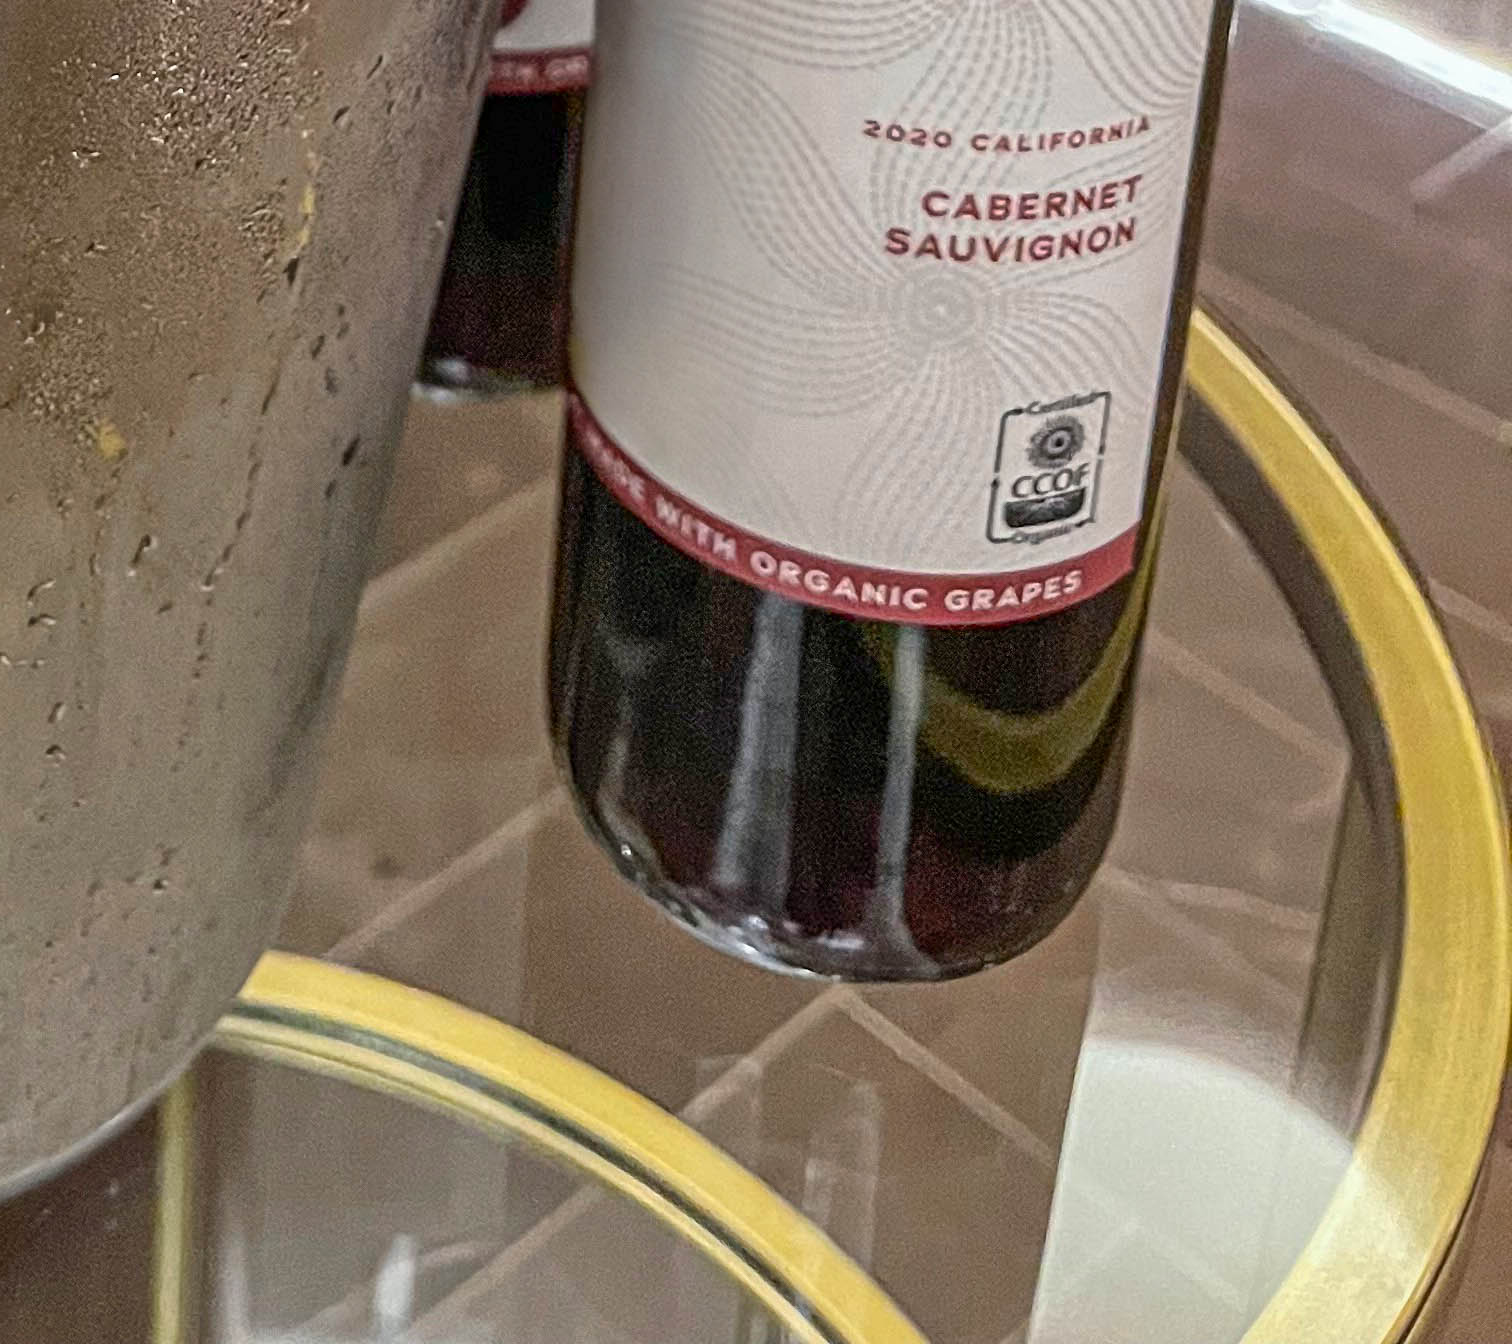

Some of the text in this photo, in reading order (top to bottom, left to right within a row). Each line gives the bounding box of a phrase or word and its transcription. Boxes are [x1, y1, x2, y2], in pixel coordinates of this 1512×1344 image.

[863, 115, 1151, 153] 2020 CALIFORNIA
[921, 174, 1144, 222] CABERNET
[885, 216, 1138, 263] SAUVIGNON
[654, 493, 737, 560] WITH
[749, 549, 929, 611] ORGANIC
[943, 569, 1084, 613] GRAPES
